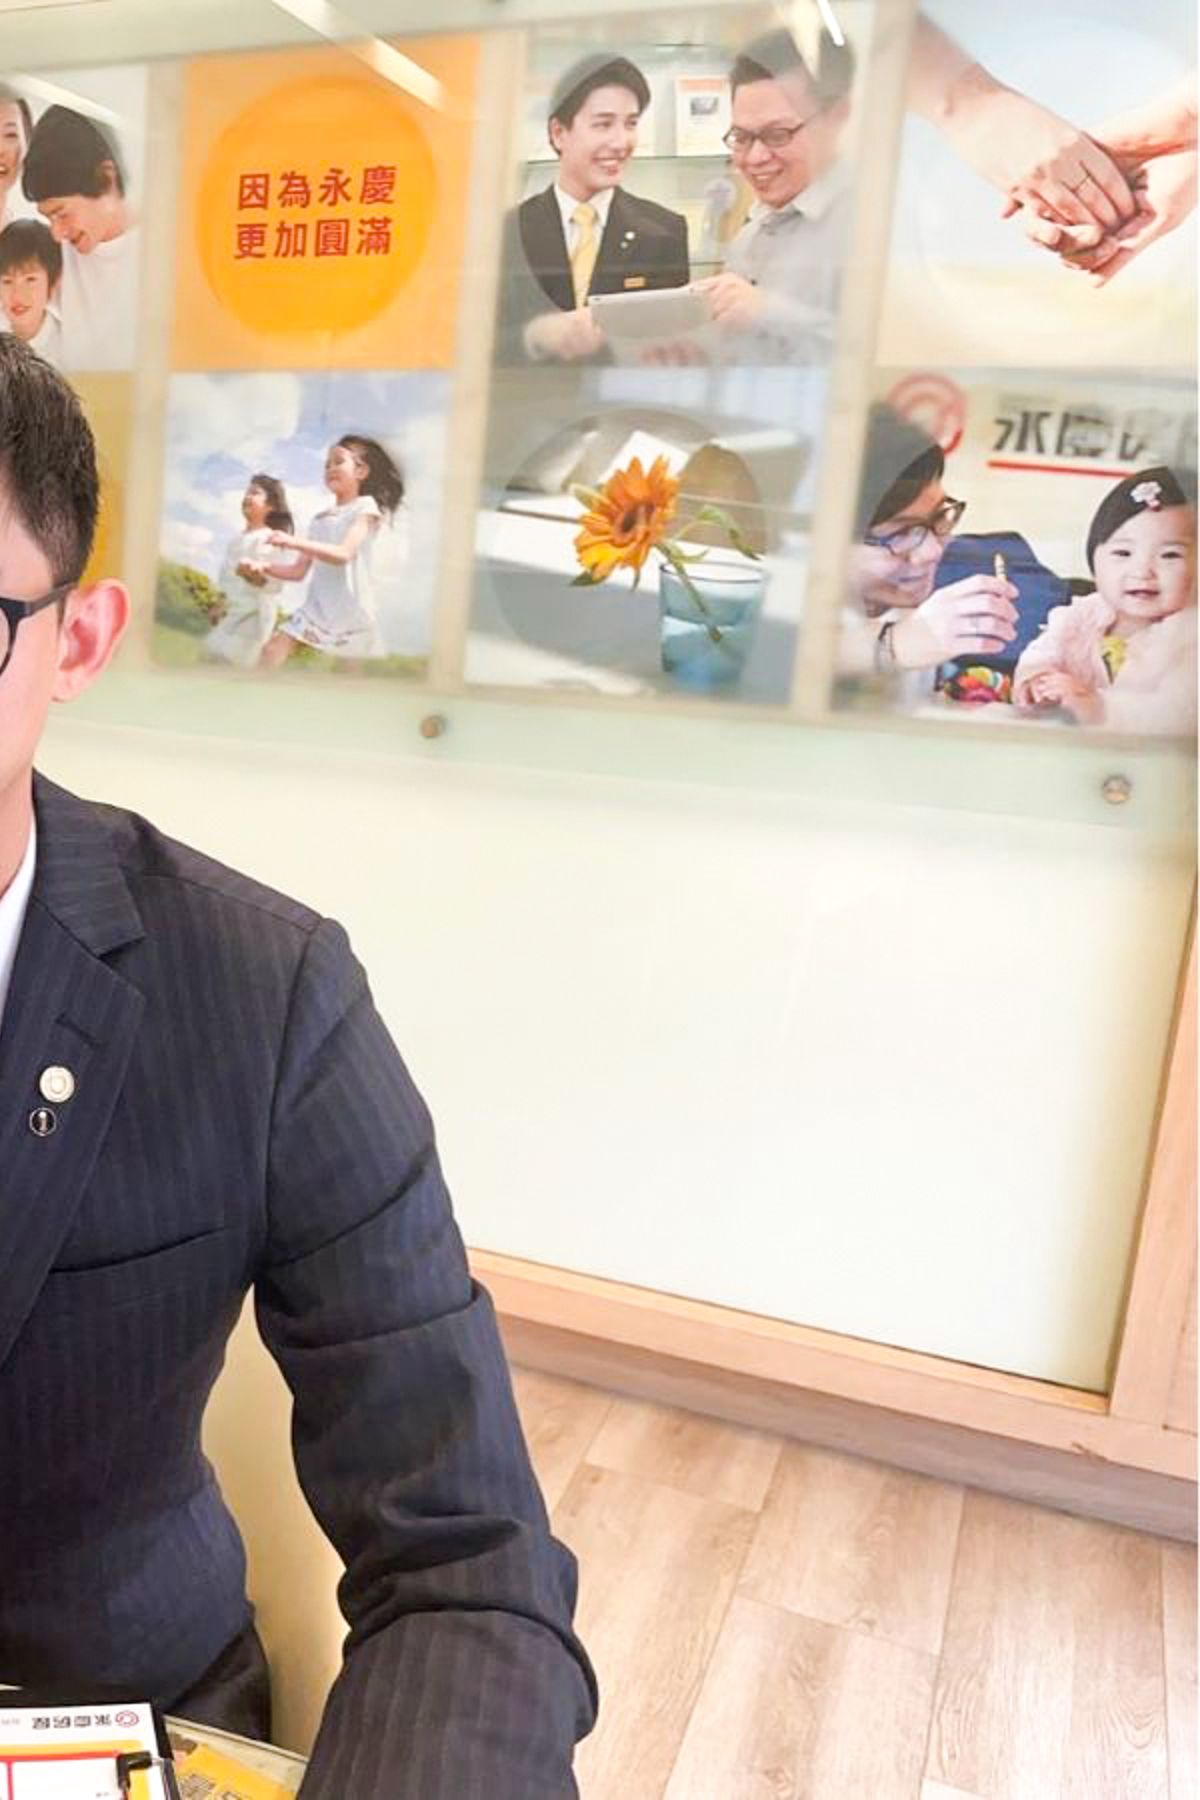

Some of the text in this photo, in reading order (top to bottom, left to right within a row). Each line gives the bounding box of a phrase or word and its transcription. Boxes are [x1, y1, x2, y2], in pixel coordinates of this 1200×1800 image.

[237, 165, 397, 211] 因為永慶
[234, 216, 393, 260] 更加圓滿
